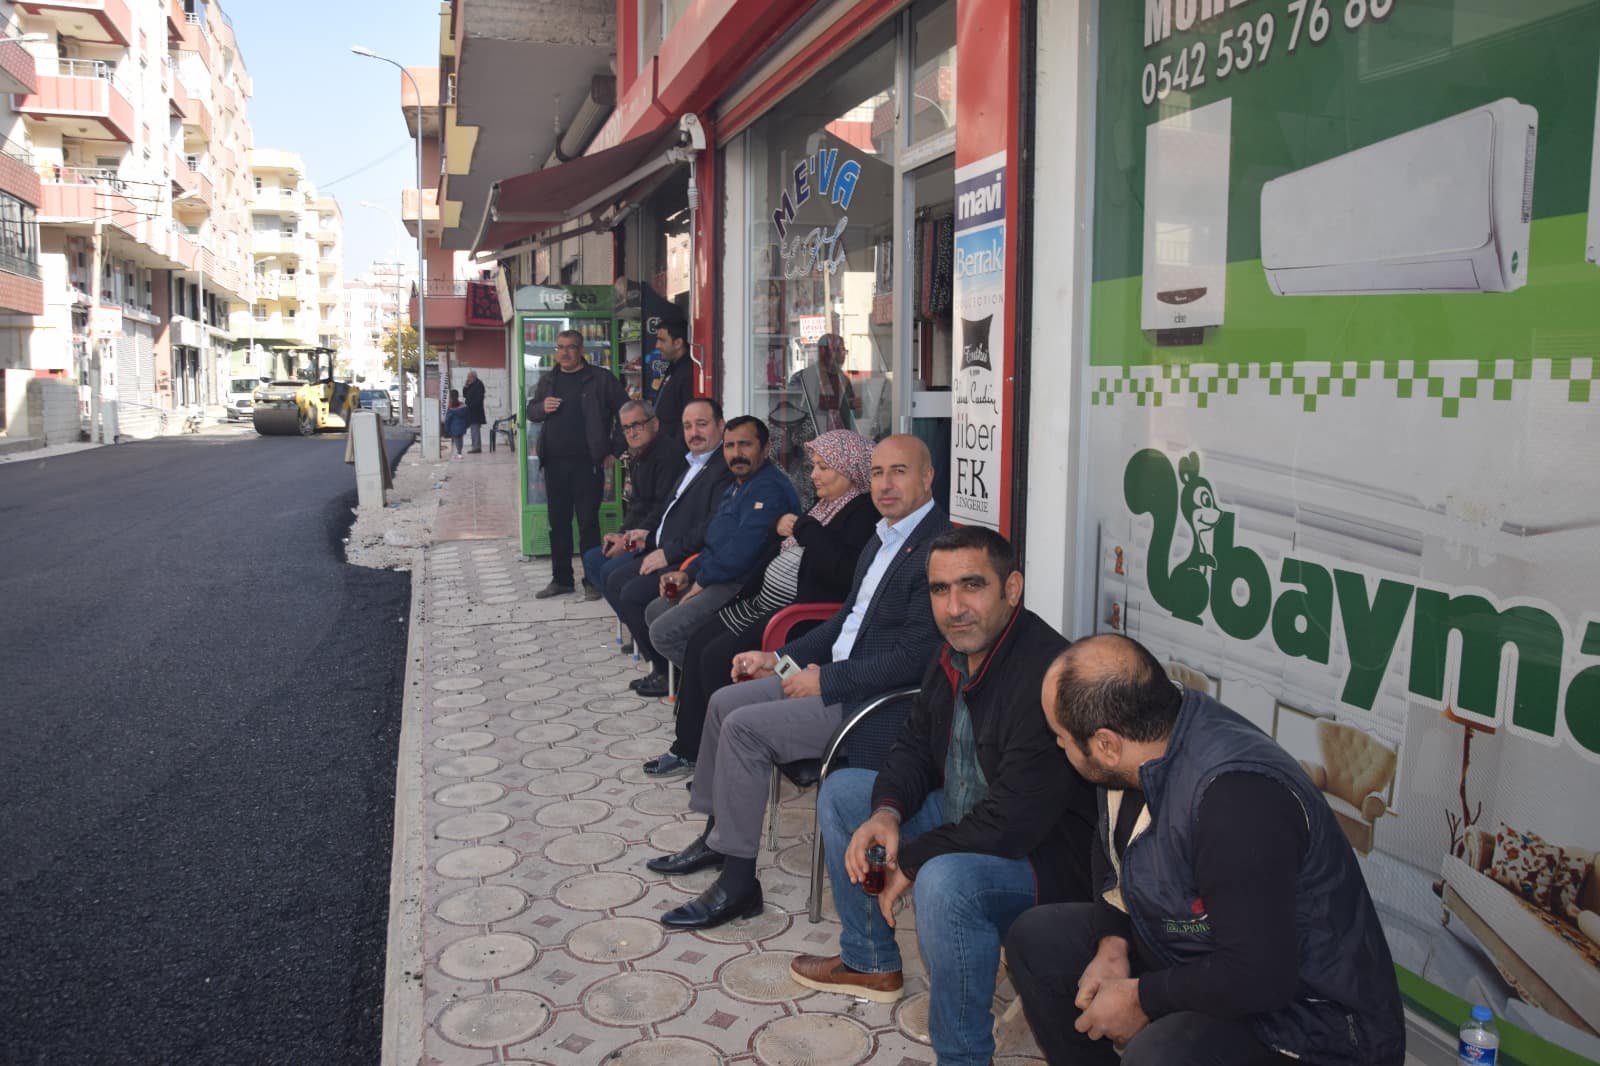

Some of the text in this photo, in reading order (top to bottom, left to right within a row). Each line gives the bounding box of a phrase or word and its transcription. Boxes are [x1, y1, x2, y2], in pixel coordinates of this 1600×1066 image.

[1142, 42, 1206, 104] 0542
[1216, 13, 1275, 78] 539
[1288, 0, 1330, 51] 76
[772, 148, 862, 241] ME'VA
[958, 173, 1002, 220] mavi
[956, 238, 1003, 280] Berrak
[955, 495, 988, 513] LINGERIE
